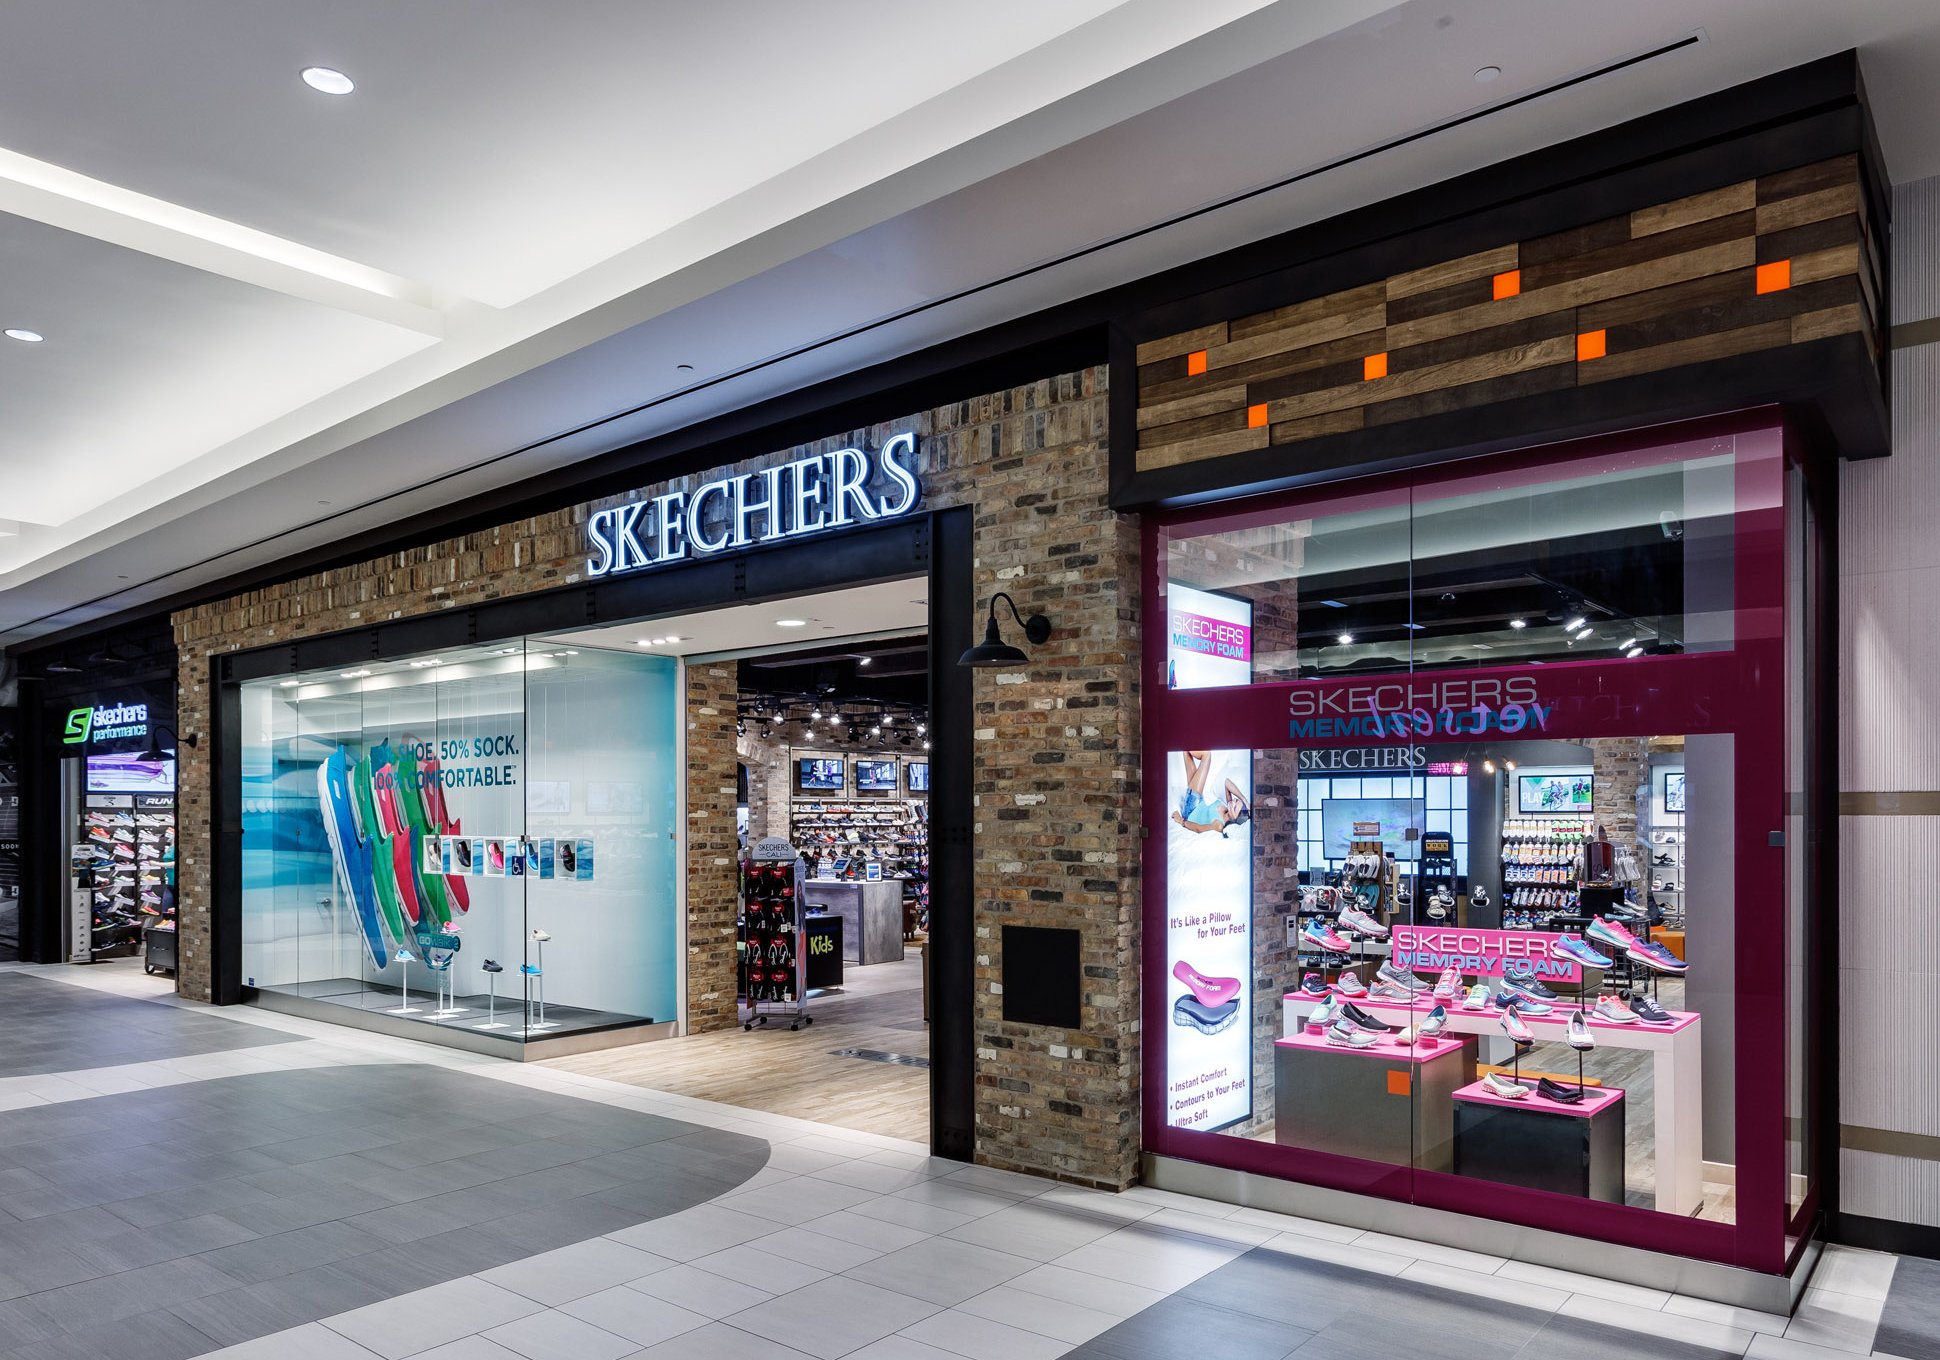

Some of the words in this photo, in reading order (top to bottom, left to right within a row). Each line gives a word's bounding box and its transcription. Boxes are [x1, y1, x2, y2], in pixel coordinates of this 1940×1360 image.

[588, 431, 921, 576] SKECHERS
[1173, 615, 1244, 645] SKECHERS
[1173, 633, 1216, 653] MEMORY
[1217, 642, 1244, 658] FOAM
[1289, 677, 1537, 716] SKECHERS
[93, 702, 148, 726] skechers
[1289, 714, 1425, 738] MEMORY
[1436, 706, 1551, 732] FOAM
[93, 724, 148, 743] performance
[441, 739, 469, 760] 50%
[474, 735, 519, 757] SOCK.
[1299, 746, 1426, 770] SKECHERS
[145, 797, 175, 805] RUN
[1523, 791, 1545, 804] PLAY
[758, 843, 789, 852] SKECHERS
[1170, 917, 1183, 929] It's
[1185, 915, 1200, 927] Like
[1202, 916, 1207, 924] a
[1209, 912, 1232, 923] Pillow
[1197, 928, 1208, 939] for
[1210, 926, 1227, 937] Your
[1229, 923, 1246, 934] Feet
[810, 935, 834, 955] Kids
[1397, 951, 1498, 971] MEMORY
[1502, 957, 1573, 977] FOAM
[1175, 1076, 1199, 1092] Instant
[1200, 1068, 1227, 1083] Comfort
[1175, 1092, 1206, 1111] Contours
[1207, 1090, 1214, 1100] to
[1215, 1085, 1230, 1096] Your
[1231, 1078, 1246, 1091] Feet
[1175, 1116, 1193, 1128] Ultra
[1194, 1109, 1209, 1122] Soft
